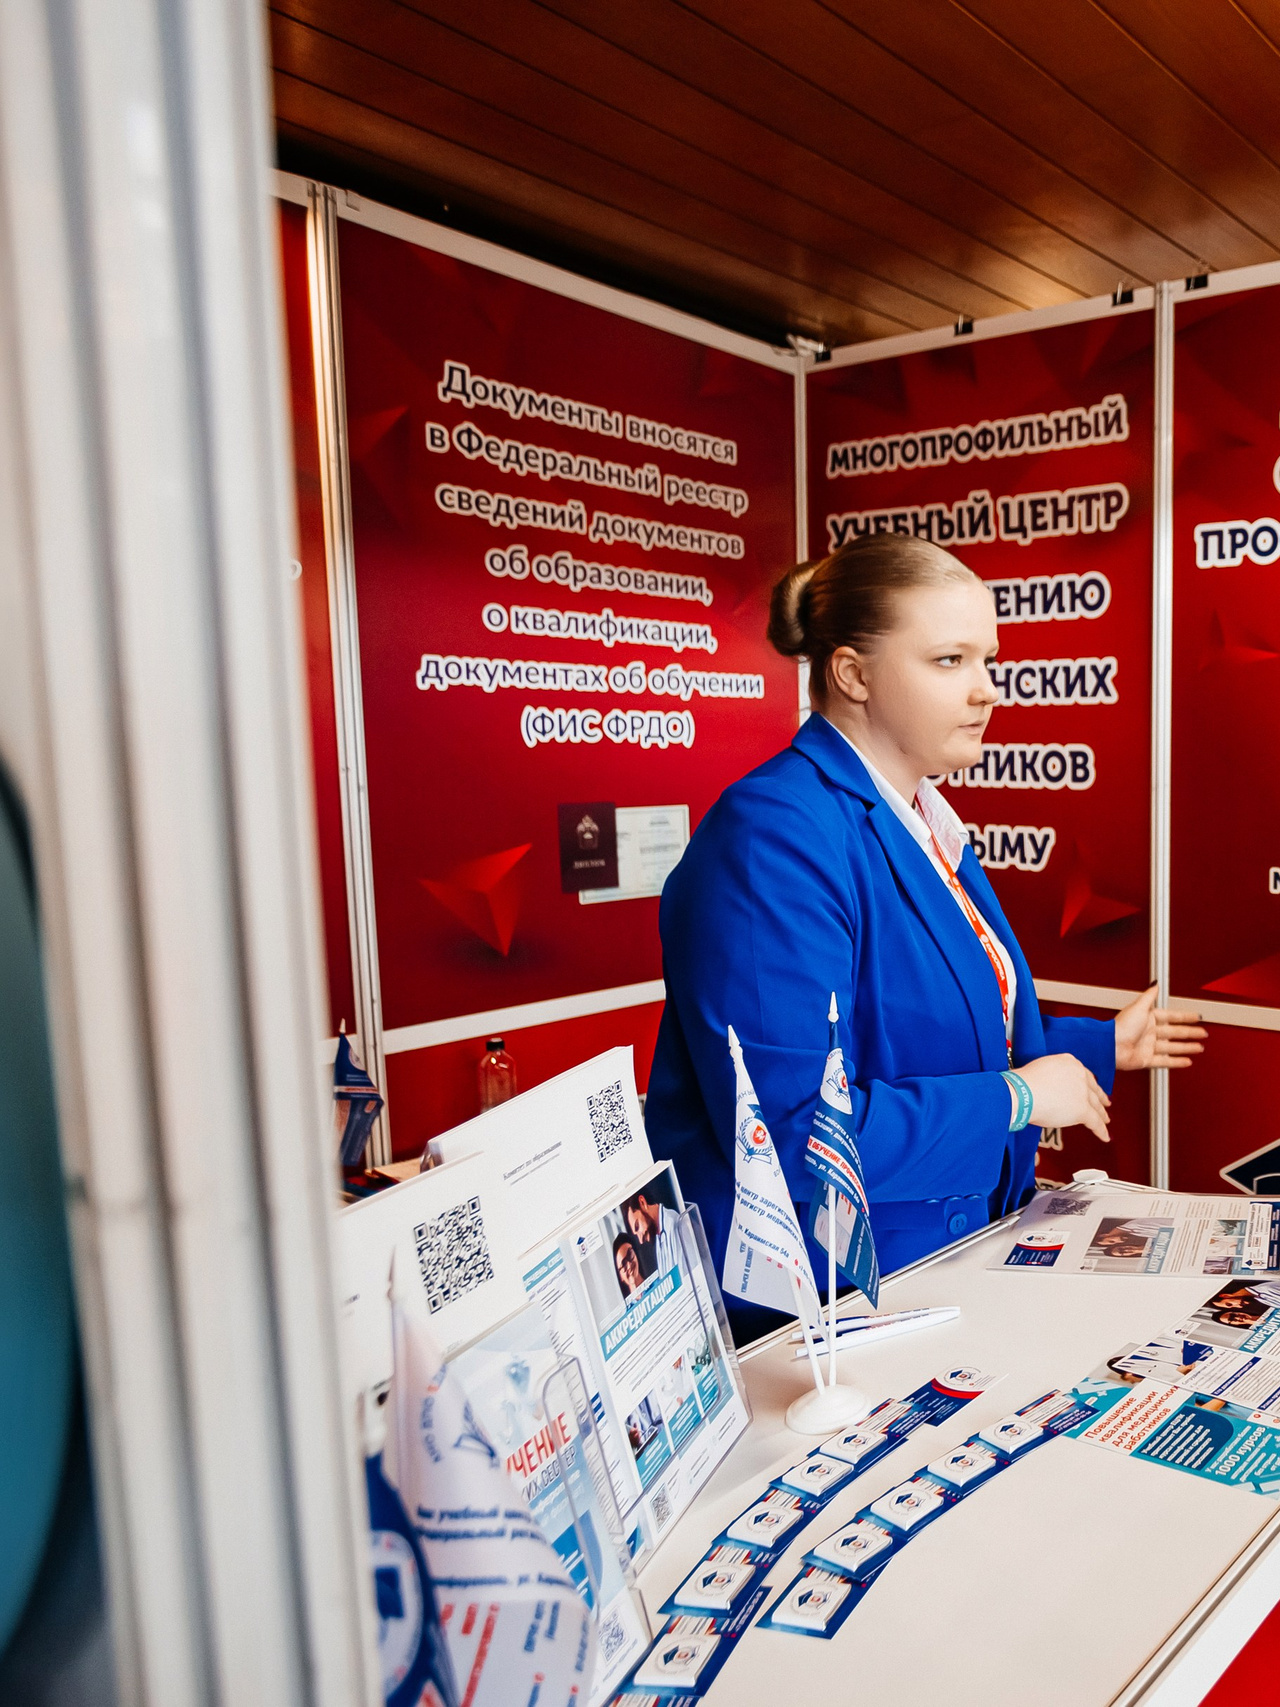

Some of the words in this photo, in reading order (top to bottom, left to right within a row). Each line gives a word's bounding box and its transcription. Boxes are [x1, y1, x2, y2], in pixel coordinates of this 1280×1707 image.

[442, 364, 621, 435] Документы
[629, 420, 735, 463] вносятся
[830, 399, 1123, 473] МНОГОПРОФИЛЬНЫЙ
[429, 426, 447, 450] в
[457, 427, 659, 494] Федеральный
[666, 476, 747, 514] реестр
[439, 488, 584, 530] сведений
[593, 514, 741, 556] документов
[1003, 490, 1124, 540] ЦЕНТР
[489, 551, 526, 576] об
[537, 556, 711, 603] образовании,
[995, 578, 1108, 618] ЕНИЮ
[487, 609, 505, 629] о
[515, 609, 715, 650] квалификации,
[421, 659, 603, 689] документах
[613, 663, 643, 689] об
[652, 667, 761, 698] обучении
[525, 710, 599, 744] (ФИС
[607, 713, 693, 746] ФРДО)
[604, 1278, 676, 1352] АККРЕДИТАЦИИ
[1084, 1393, 1136, 1439] Повышение
[1098, 1389, 1158, 1442] квалификации
[1111, 1429, 1129, 1447] для
[1127, 1383, 1179, 1430] медицинских
[1123, 1405, 1170, 1451] работников
[1214, 1452, 1241, 1476] 1000
[1236, 1425, 1266, 1454] курсов
